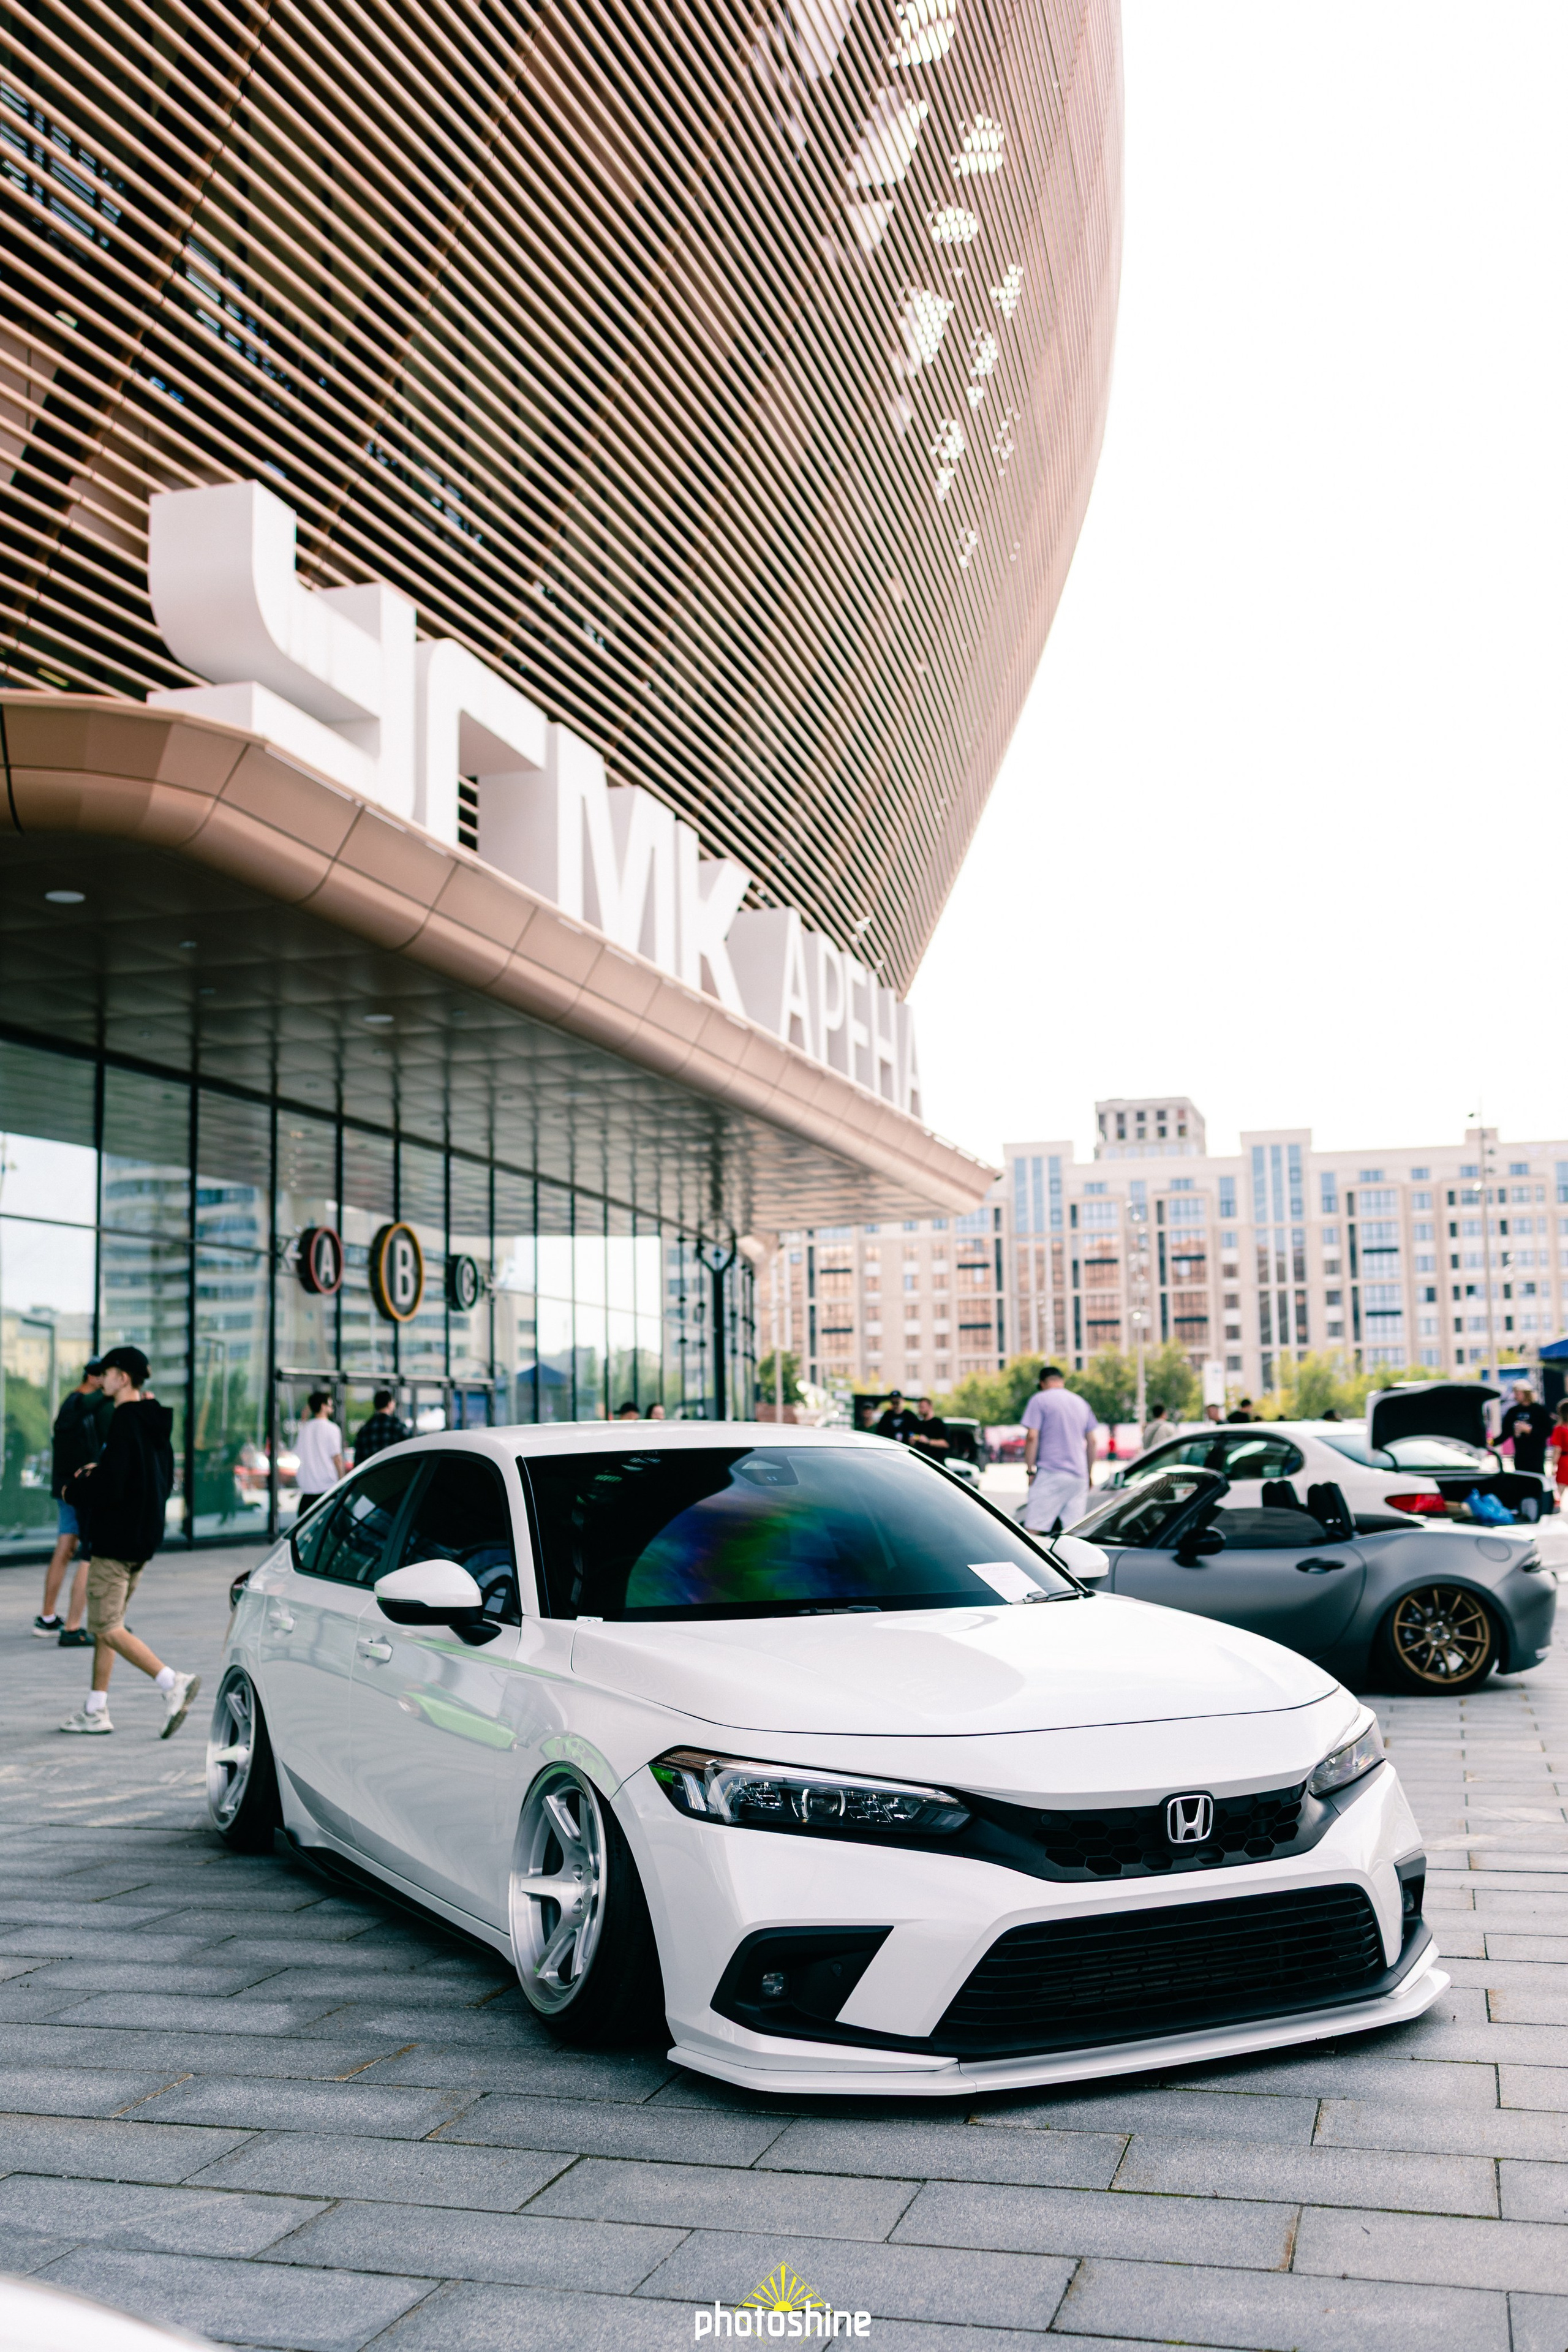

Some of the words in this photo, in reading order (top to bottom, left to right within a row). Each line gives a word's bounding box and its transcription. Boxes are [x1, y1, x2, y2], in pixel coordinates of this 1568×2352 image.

[148, 480, 751, 1025] УГМК
[777, 906, 924, 1122] АРЕНА
[318, 1236, 336, 1285] A
[394, 1237, 416, 1306] B
[461, 1261, 477, 1304] C
